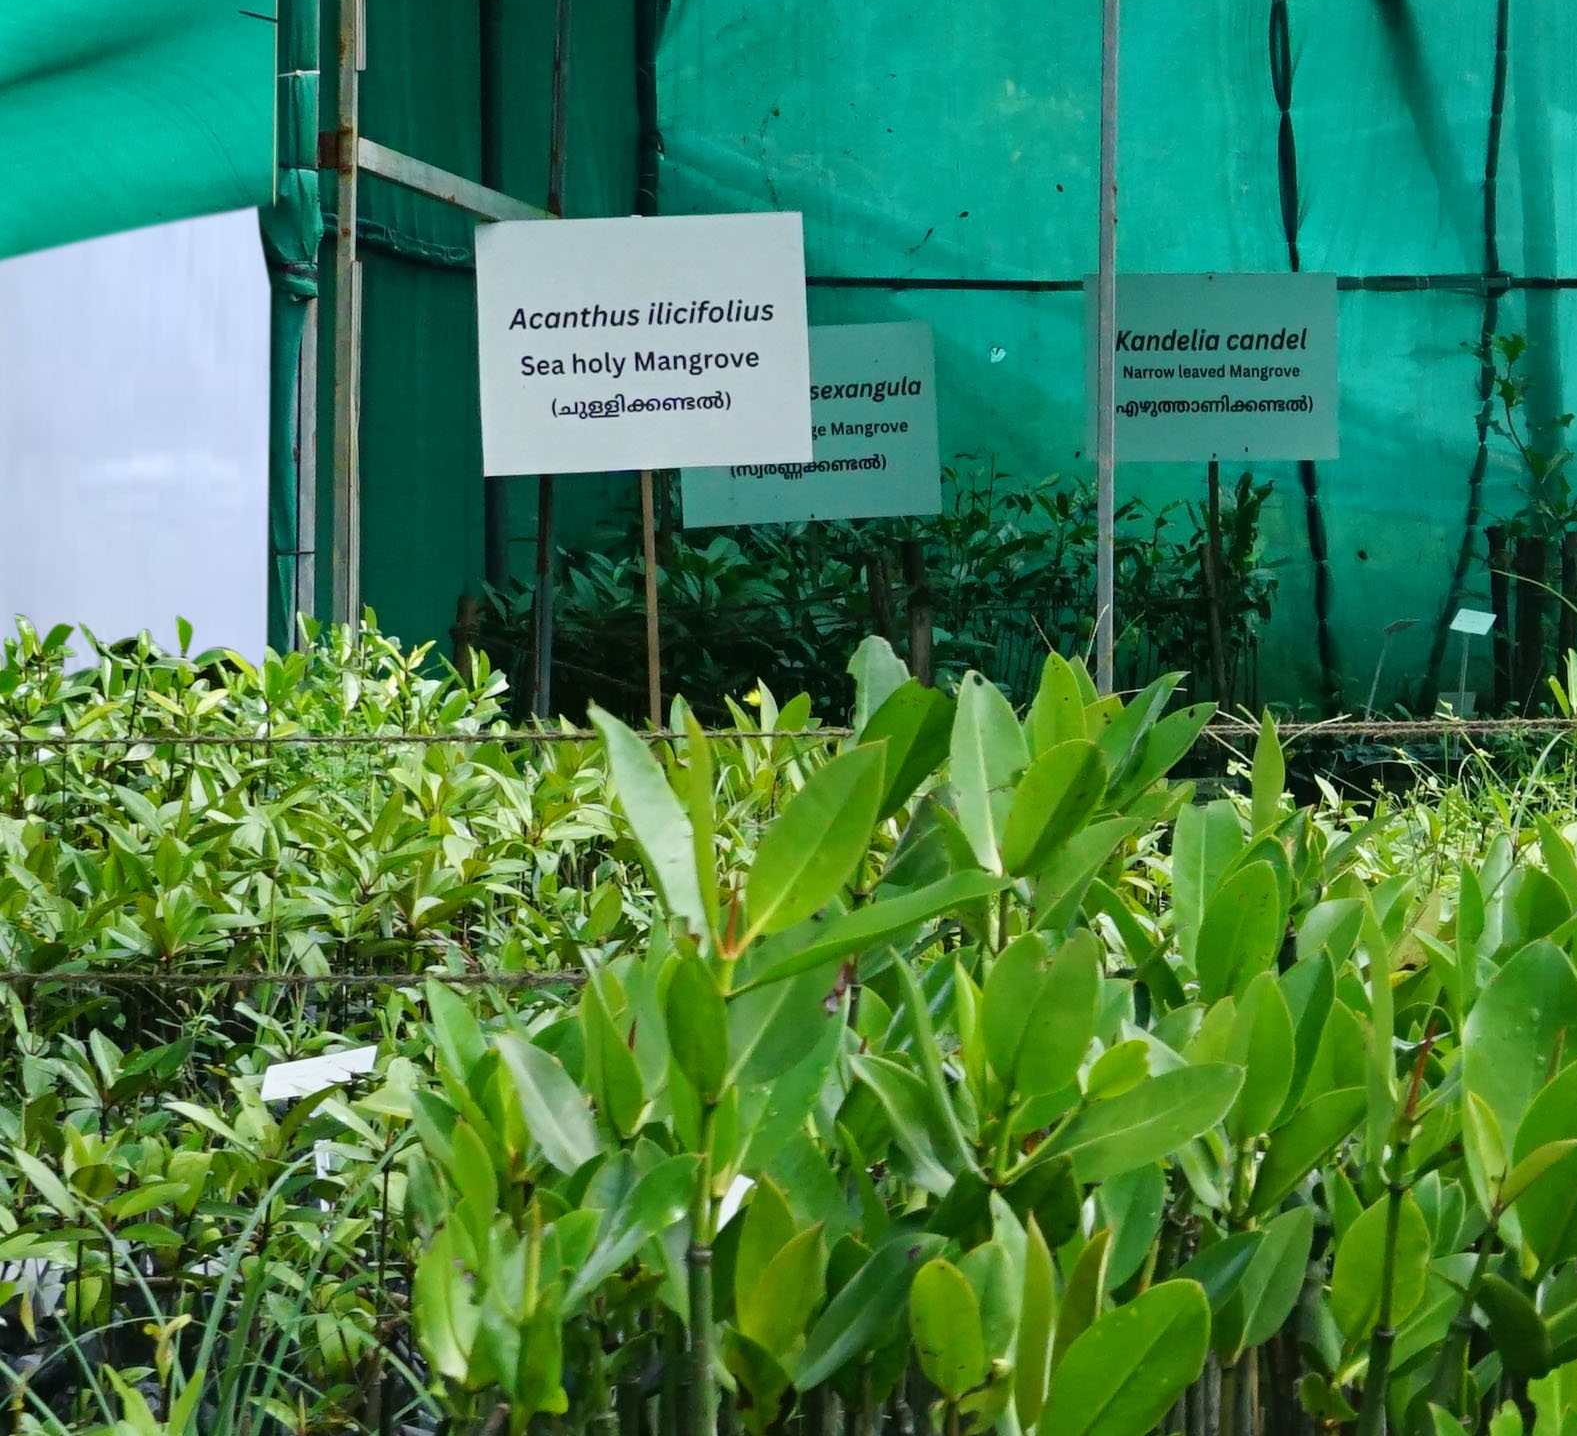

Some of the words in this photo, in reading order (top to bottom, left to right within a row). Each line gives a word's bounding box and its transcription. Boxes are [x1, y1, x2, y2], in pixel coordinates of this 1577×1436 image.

[509, 304, 640, 331] Acanthus
[648, 299, 775, 325] ilicifolius
[1116, 329, 1220, 351] Kandelia
[1227, 328, 1307, 350] candel
[521, 355, 565, 376] Sea
[572, 352, 625, 378] holy
[634, 349, 760, 375] Mangrove
[1123, 366, 1175, 379] Narrow
[1179, 365, 1225, 378] leaved
[1230, 365, 1300, 381] Mangrove
[810, 376, 921, 402] sexangula
[1116, 395, 1313, 417] എഴുത്താണിക്കണ്ടൽ)
[831, 421, 908, 437] Mangrove
